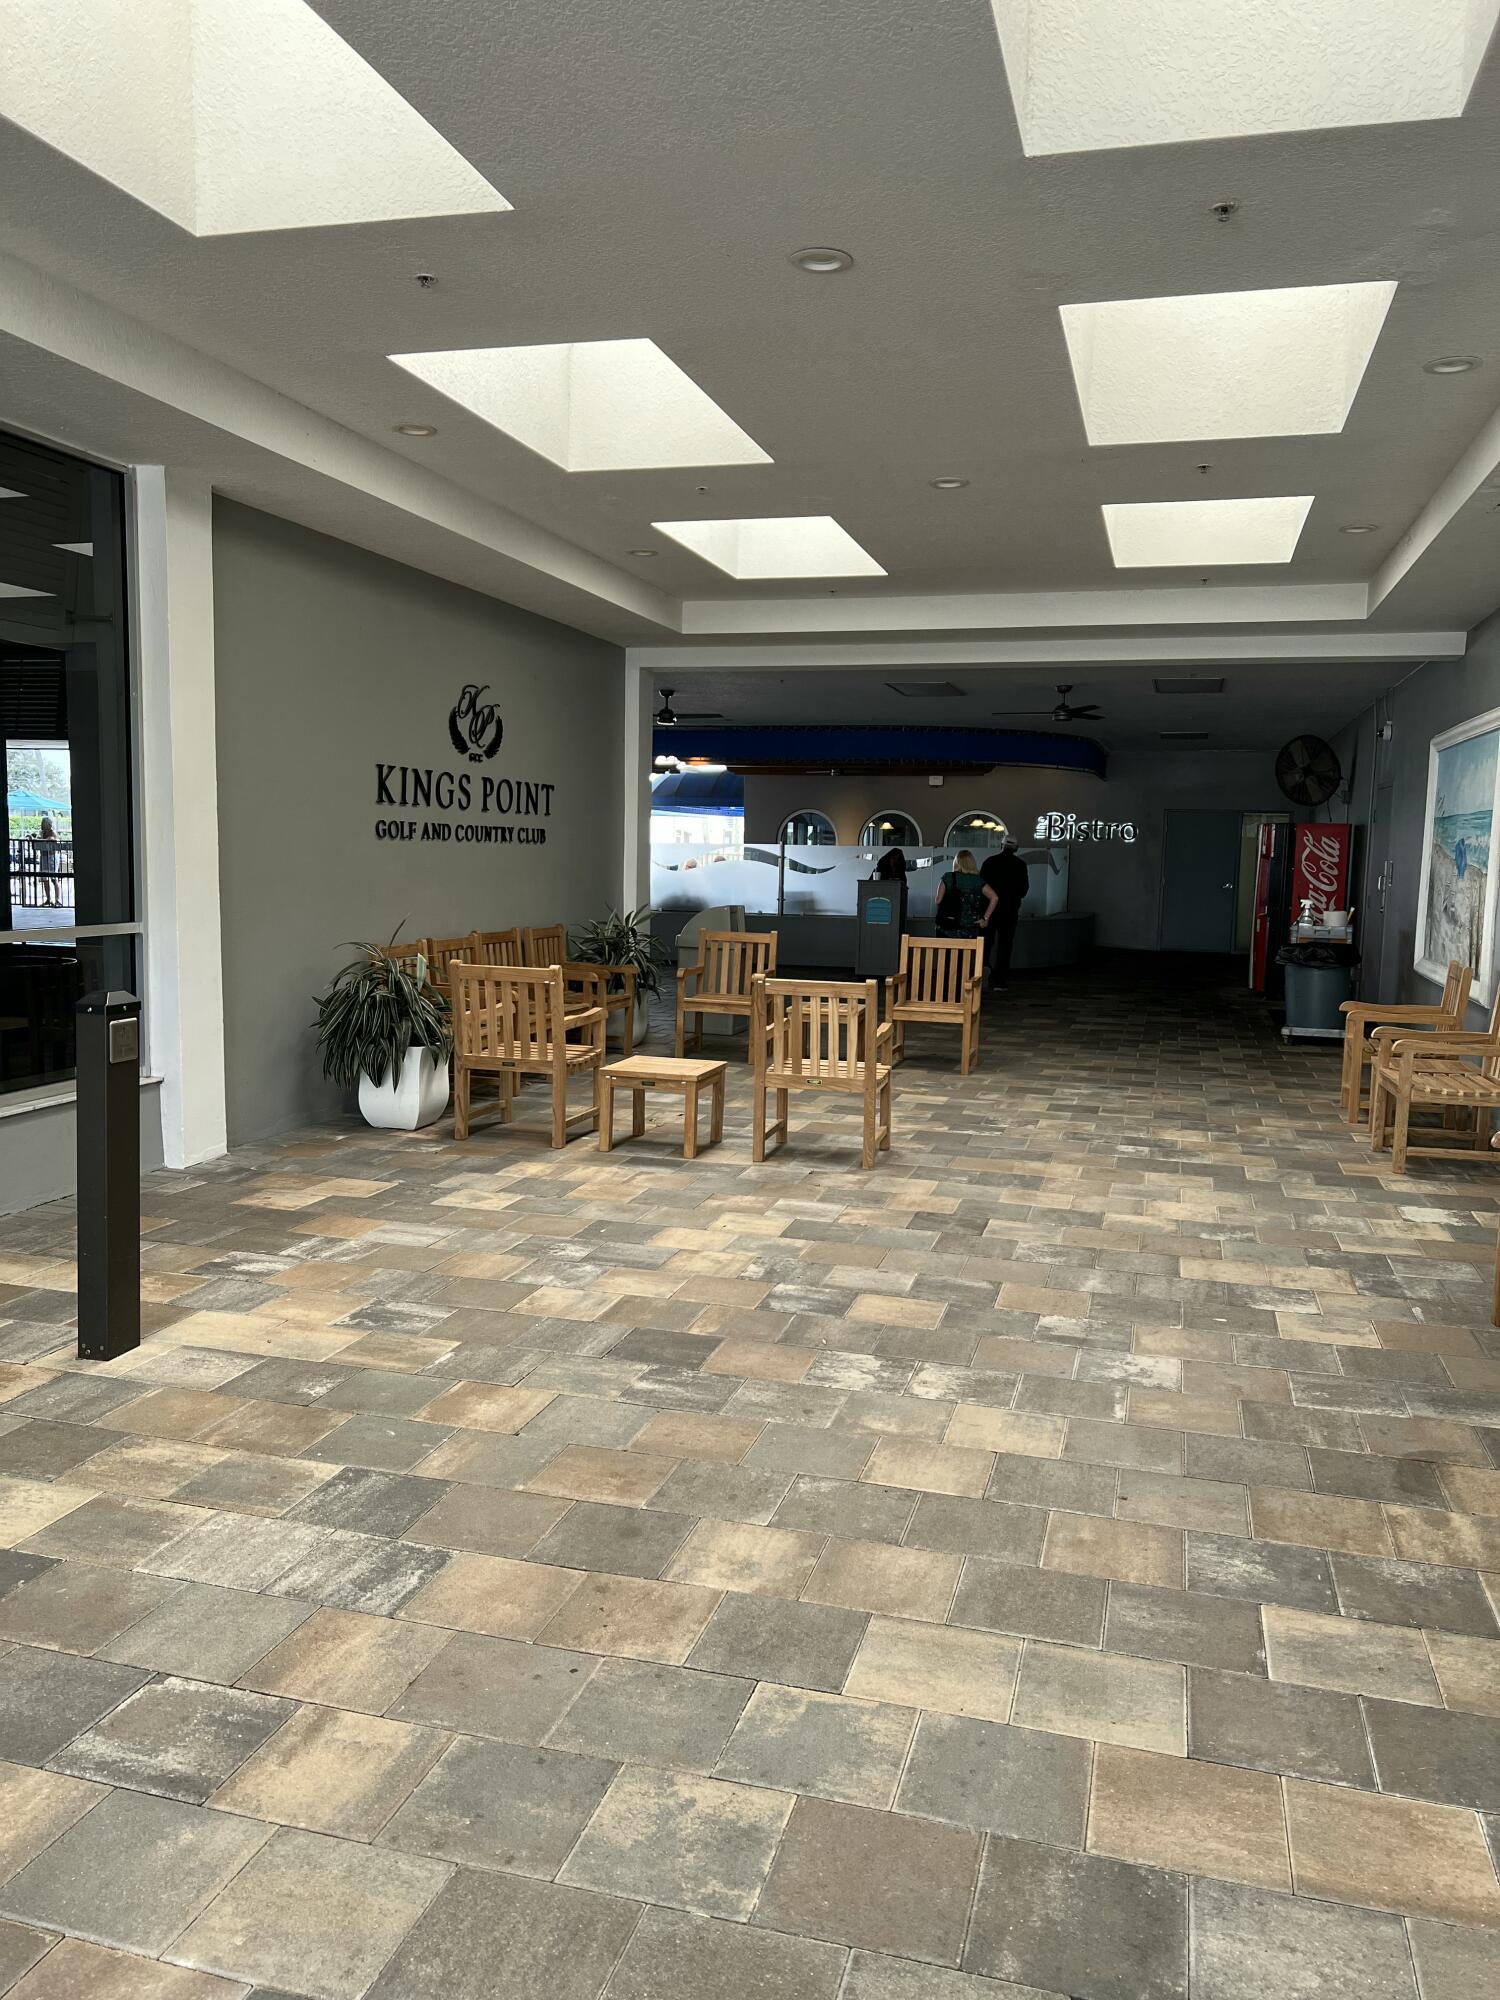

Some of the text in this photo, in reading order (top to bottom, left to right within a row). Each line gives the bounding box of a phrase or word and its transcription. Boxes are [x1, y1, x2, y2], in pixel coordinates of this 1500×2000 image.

[375, 763, 555, 816] KINGS POINT
[375, 819, 546, 845] GOLF AND COUNTRY CLUB
[1046, 811, 1139, 843] Bistro
